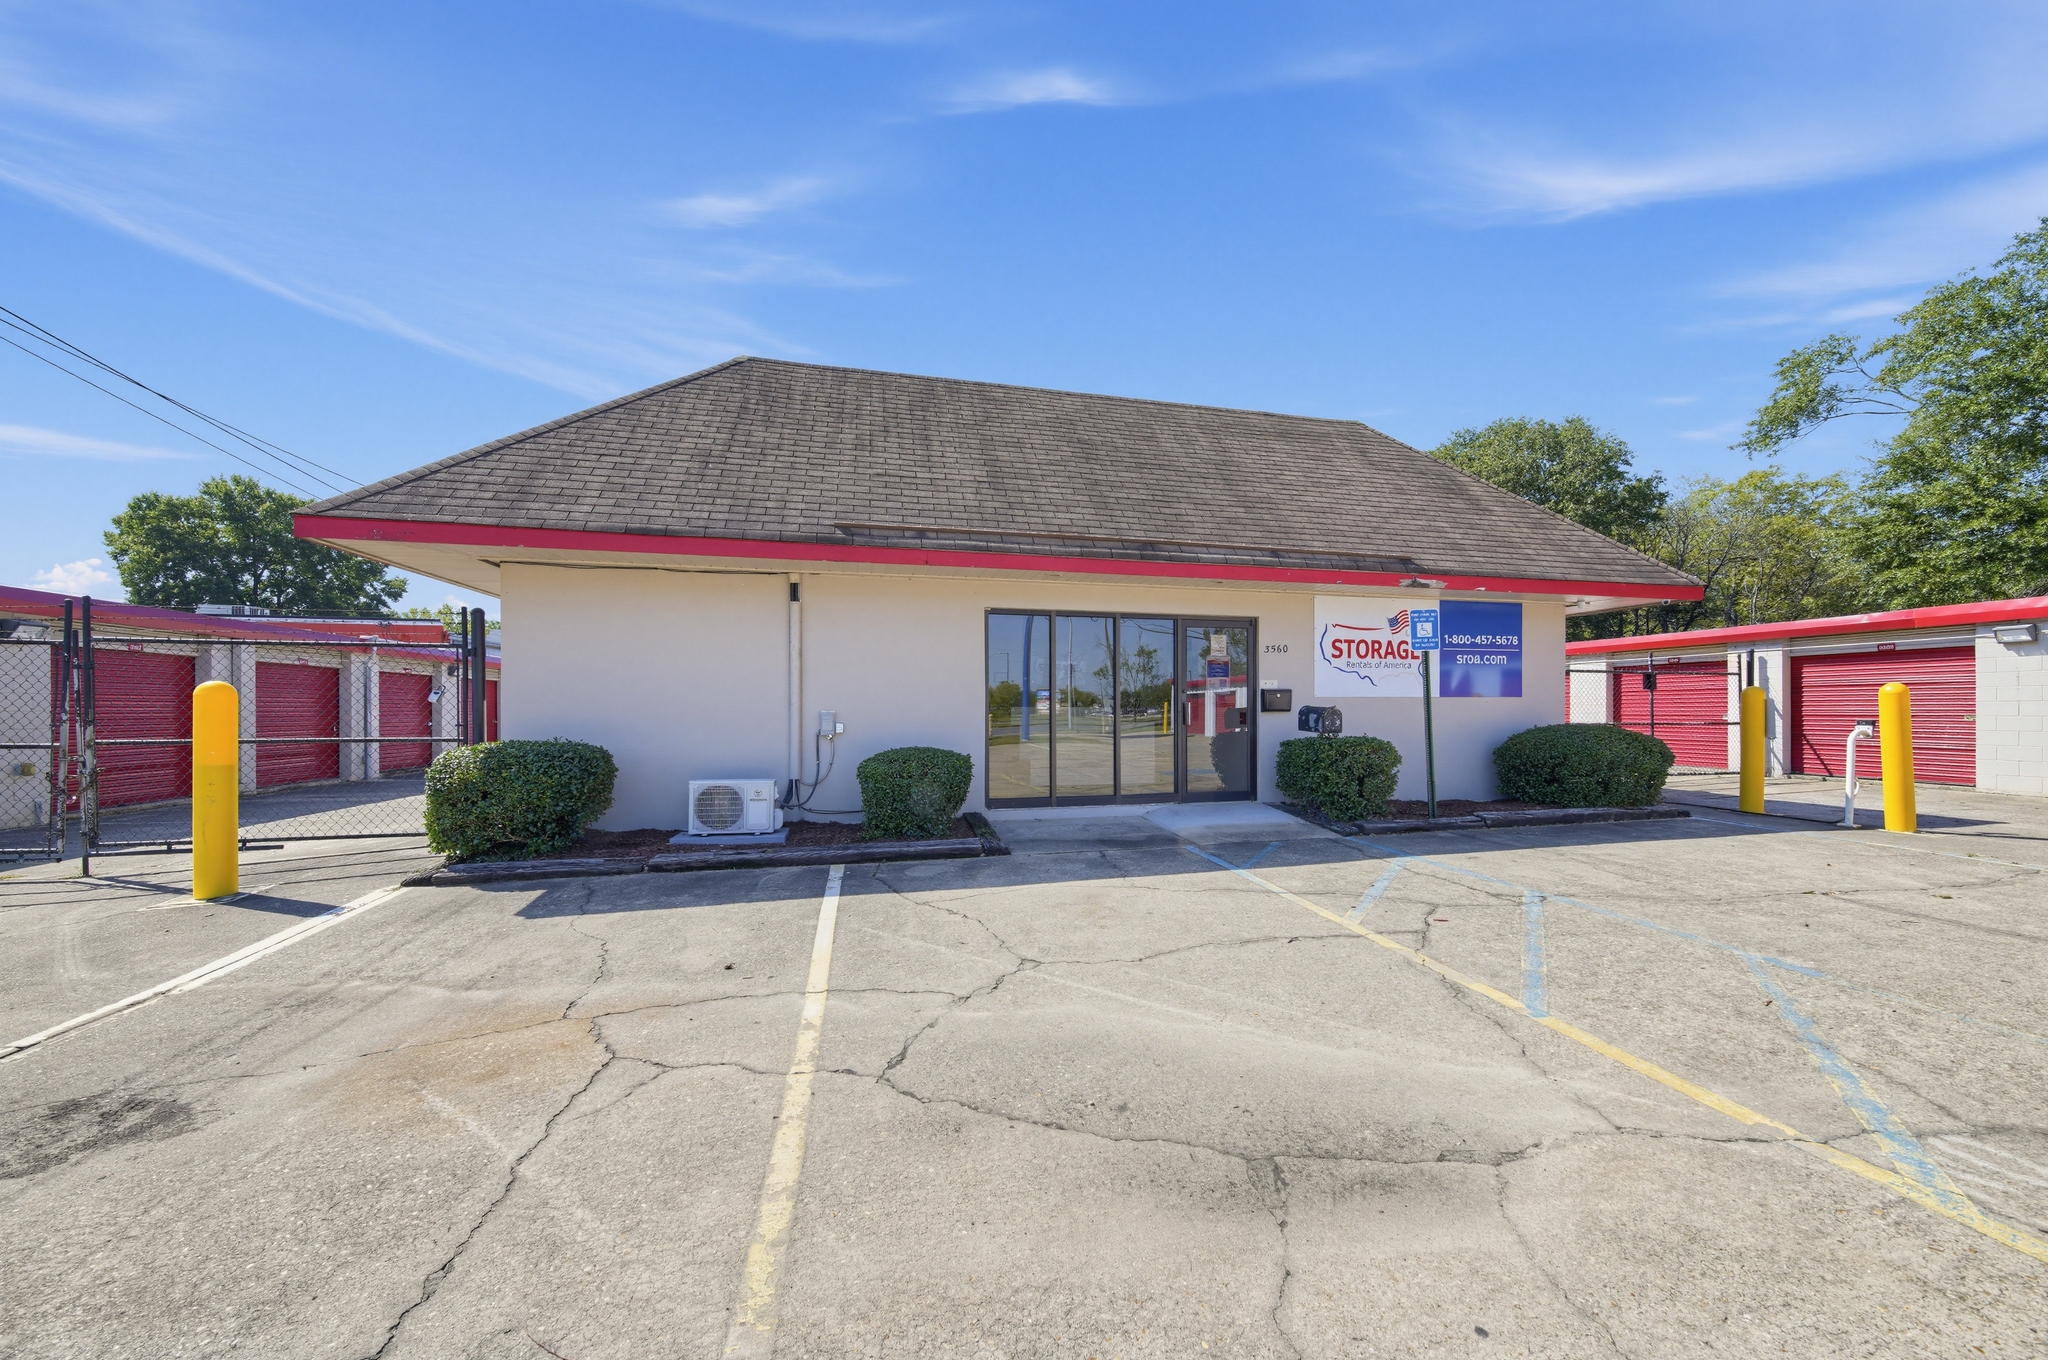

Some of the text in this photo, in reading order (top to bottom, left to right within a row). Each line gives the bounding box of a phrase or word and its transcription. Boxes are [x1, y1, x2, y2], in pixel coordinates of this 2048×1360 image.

[1444, 634, 1519, 645] 1-800-457-5678
[1263, 644, 1289, 654] 3560
[1456, 654, 1507, 665] sroa.com
[1346, 660, 1412, 670] Rentals of America
